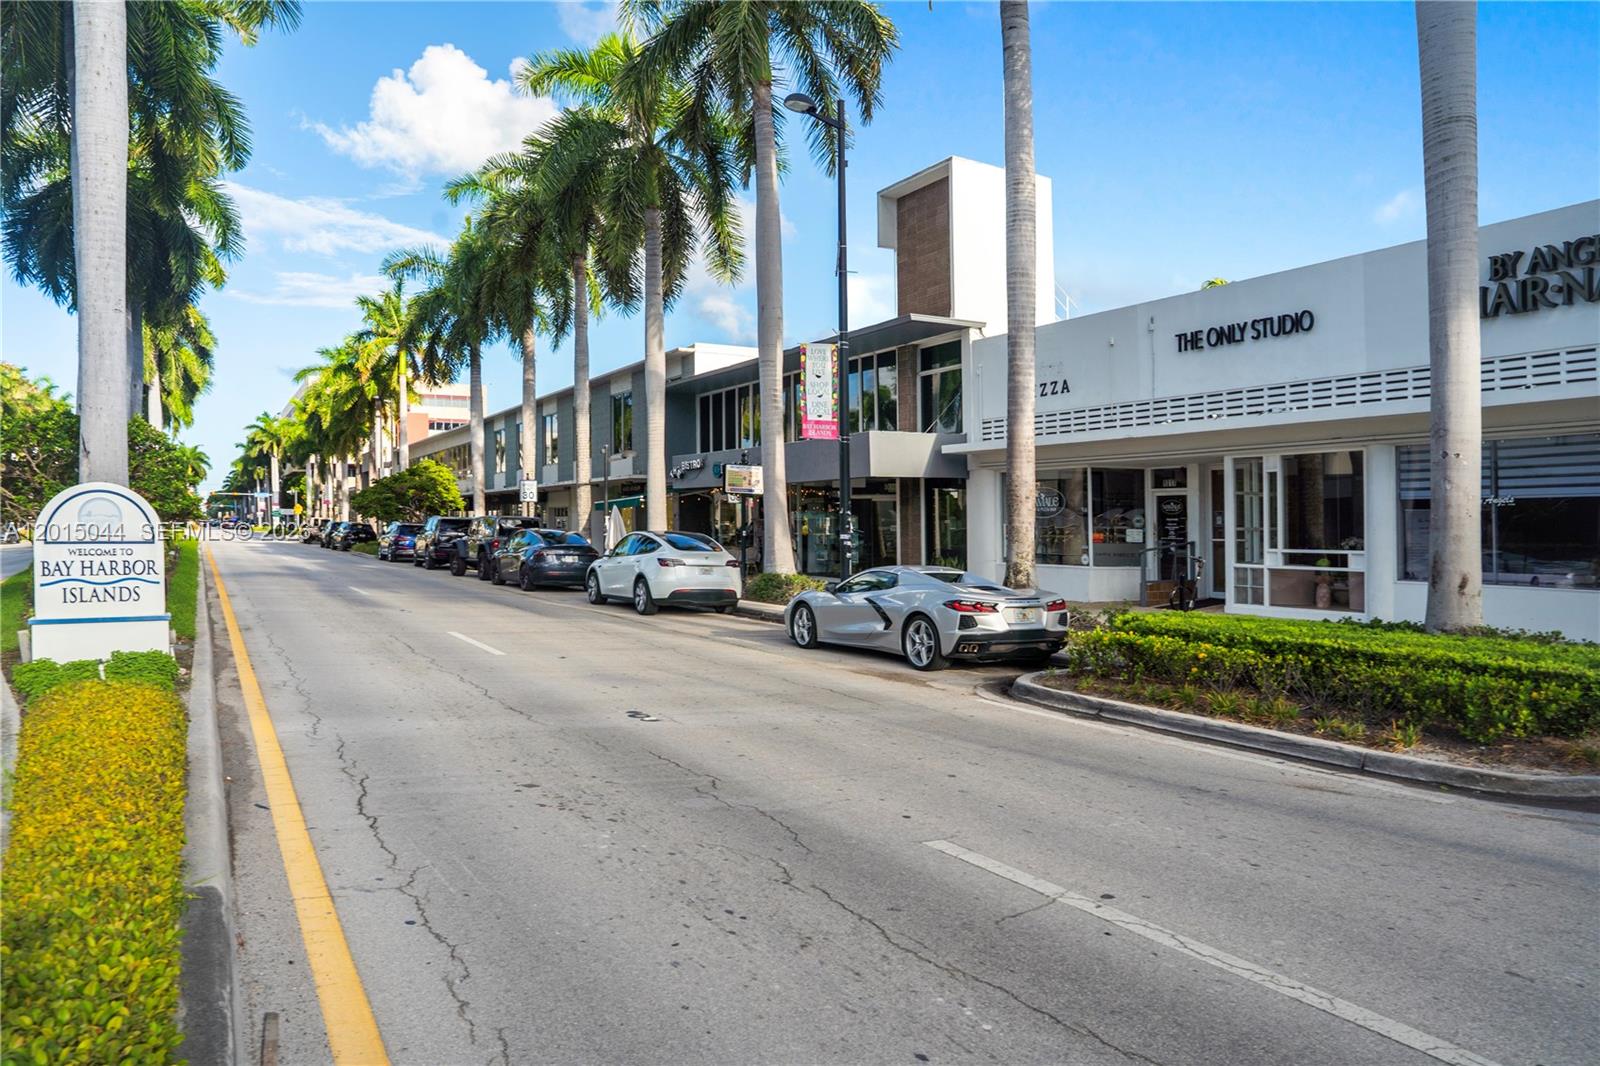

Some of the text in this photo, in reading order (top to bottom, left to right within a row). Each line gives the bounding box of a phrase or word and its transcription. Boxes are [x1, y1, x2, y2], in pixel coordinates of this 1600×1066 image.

[1488, 251, 1525, 281] BY
[1175, 310, 1315, 352] THE ONLY STUDIO
[1035, 379, 1071, 397] ZZA
[681, 458, 701, 470] BISTRO
[522, 491, 535, 500] 30
[68, 548, 134, 556] WELCOME TO
[40, 560, 159, 577] BAY HARBOR
[62, 586, 141, 603] ISLANDS
